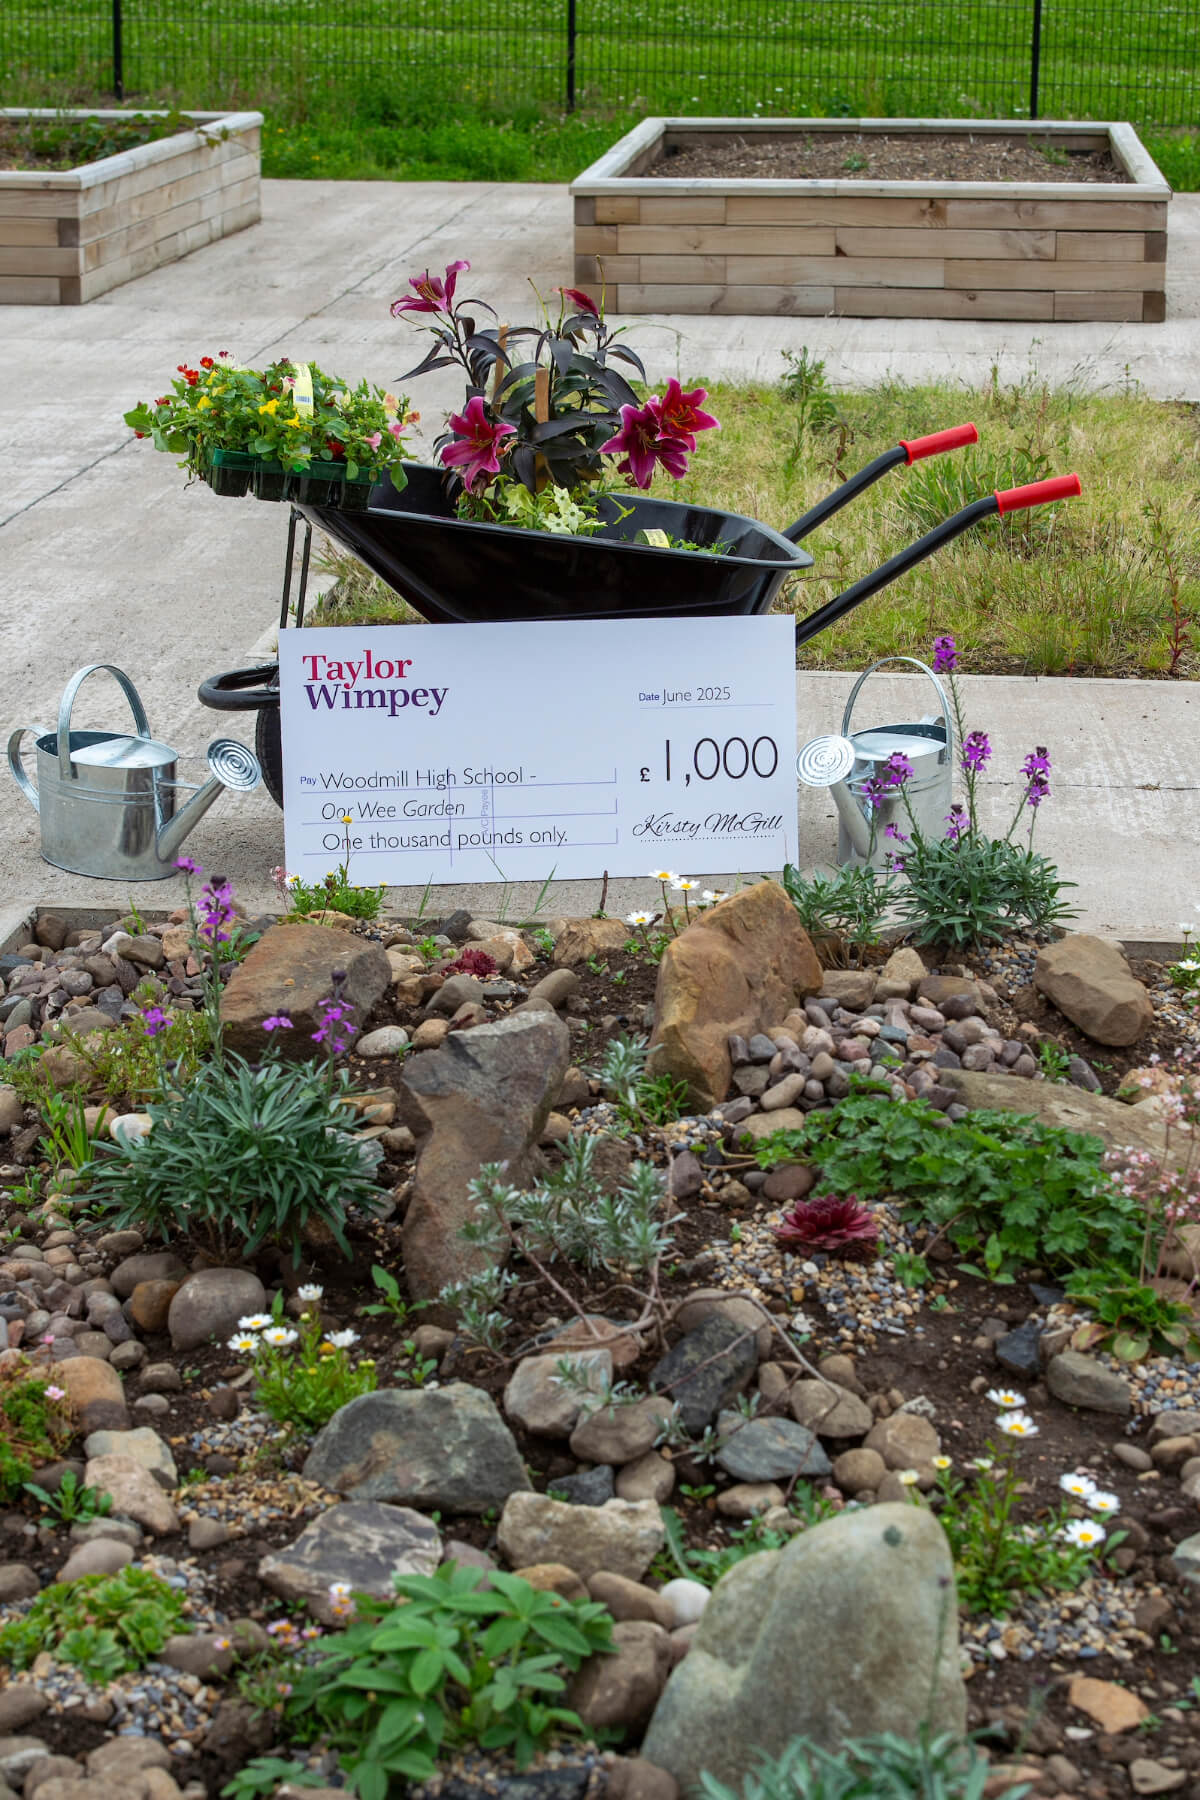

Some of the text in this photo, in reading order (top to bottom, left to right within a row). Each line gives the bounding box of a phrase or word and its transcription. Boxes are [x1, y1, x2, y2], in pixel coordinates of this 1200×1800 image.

[302, 649, 413, 690] Taylor
[303, 683, 450, 717] Wimpey
[638, 686, 731, 705] Date June 2025
[639, 735, 779, 788] £ 1,000
[300, 776, 317, 787] Pay
[319, 770, 409, 790] Woodmill
[416, 768, 457, 791] High
[463, 766, 523, 785] School
[357, 801, 396, 819] Wee
[402, 799, 465, 817] Garden
[322, 824, 568, 851] One thousand pounds only.
[632, 811, 783, 838] Kirsty McGill
